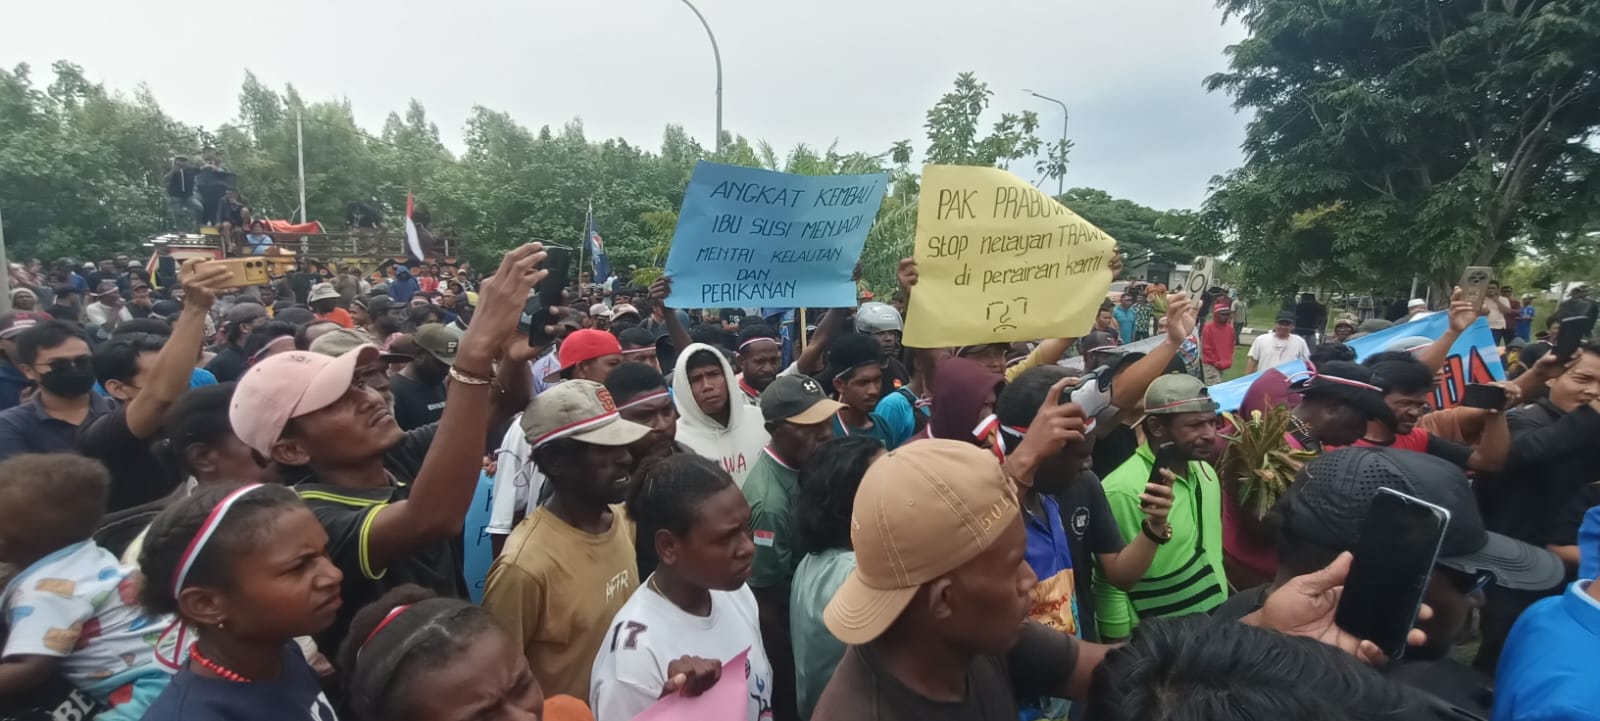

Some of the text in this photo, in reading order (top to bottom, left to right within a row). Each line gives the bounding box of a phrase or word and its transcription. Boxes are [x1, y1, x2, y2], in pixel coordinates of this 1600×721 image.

[709, 180, 806, 208] ANGKAT
[936, 188, 978, 220] PAK
[712, 213, 864, 239] IBU SUSI MENJADI
[696, 246, 843, 264] MENTRI KELAUTAN
[980, 231, 1053, 257] nelayan
[736, 268, 771, 281] DAN
[954, 250, 1105, 292] di perairan kami
[702, 280, 797, 304] PERIKANAN
[610, 619, 649, 654] 17
